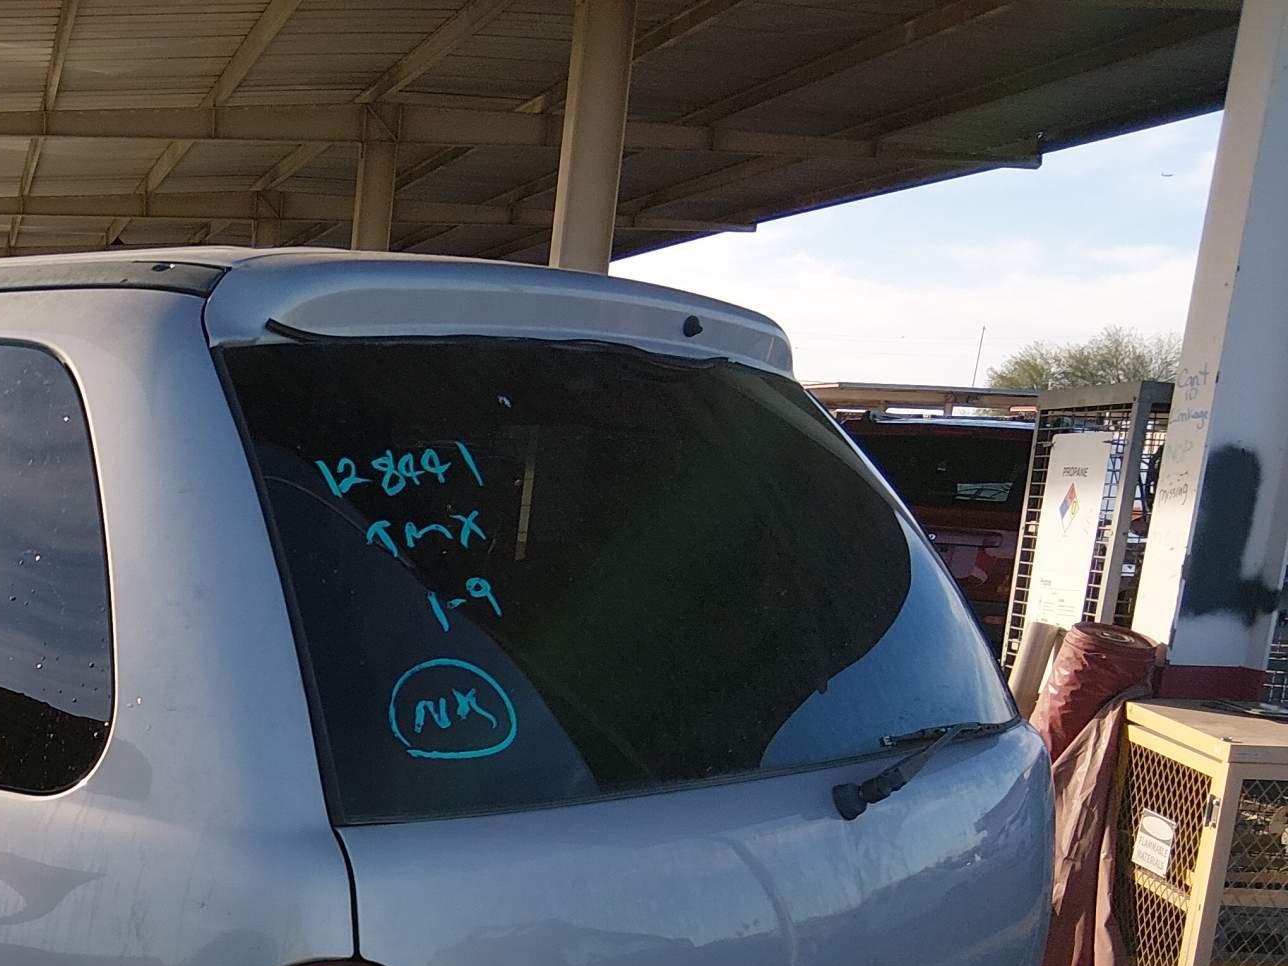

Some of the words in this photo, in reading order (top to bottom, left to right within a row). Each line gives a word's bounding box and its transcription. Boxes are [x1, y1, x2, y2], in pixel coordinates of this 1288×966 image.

[1062, 466, 1089, 478] PROPANE
[426, 576, 502, 633] 1-9
[1139, 835, 1169, 858] FLAMMABLE
